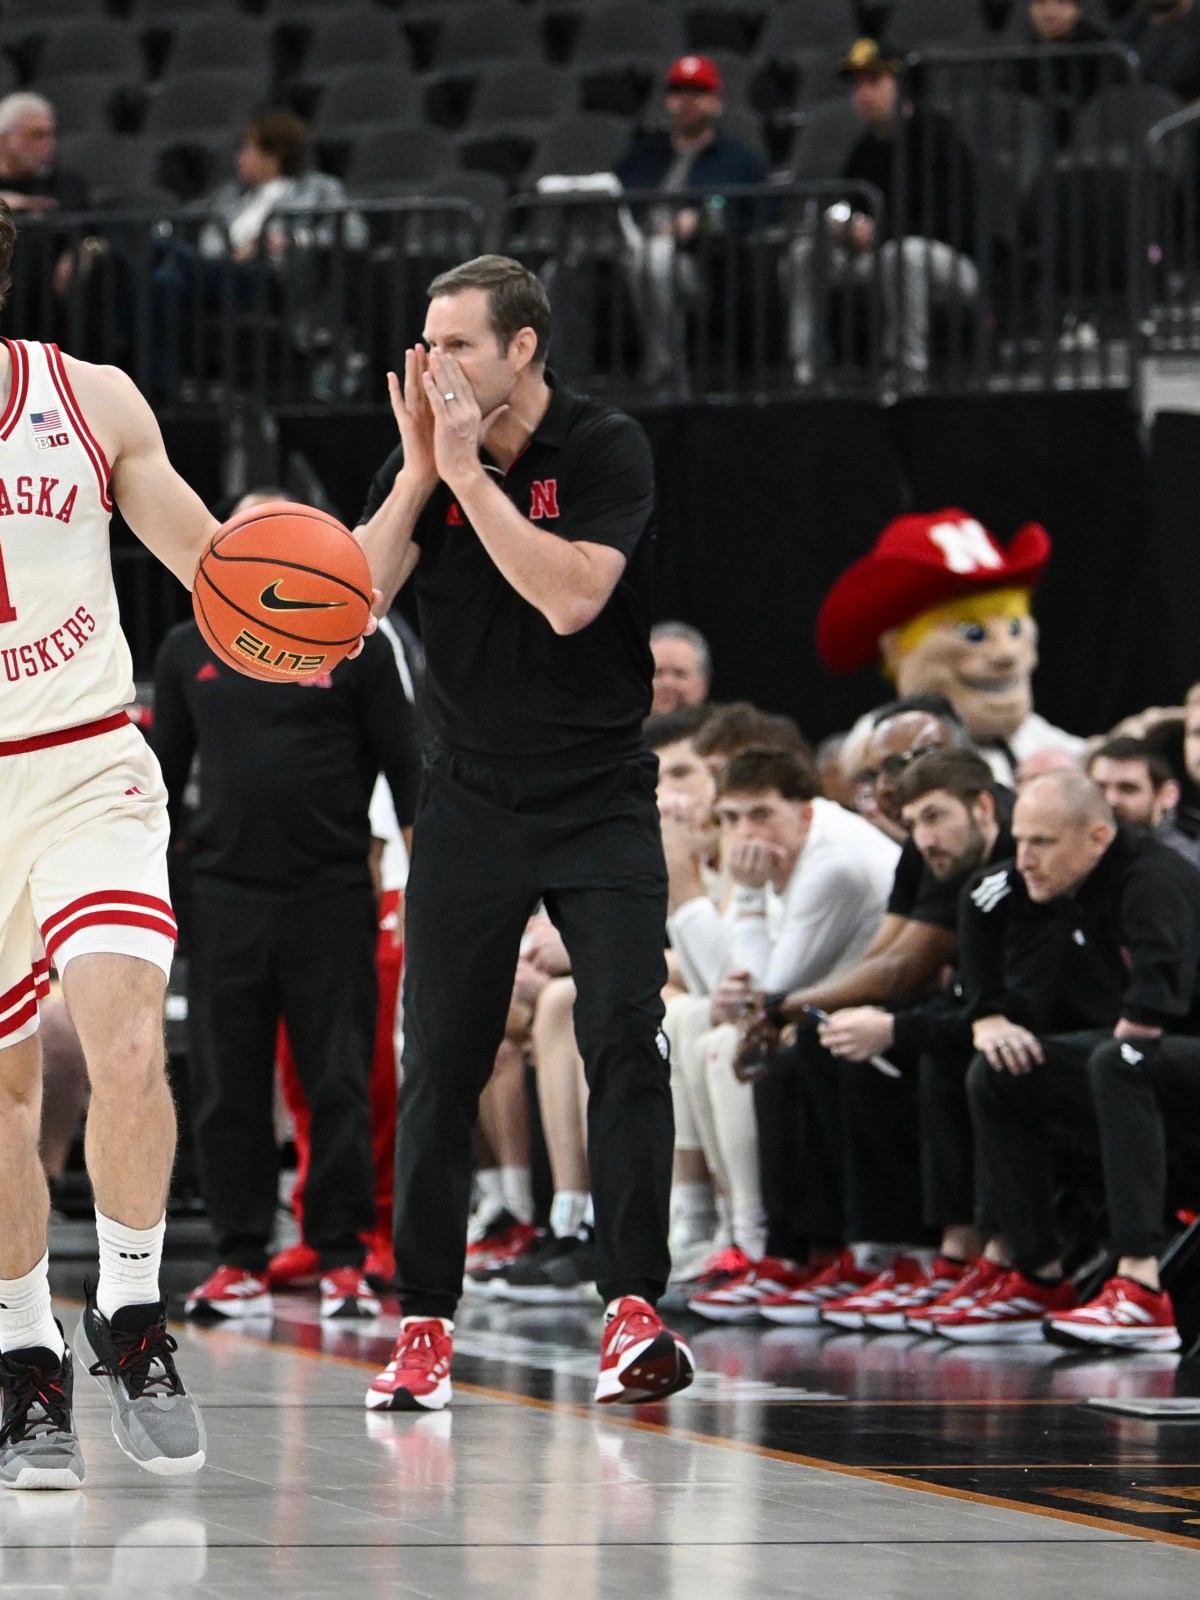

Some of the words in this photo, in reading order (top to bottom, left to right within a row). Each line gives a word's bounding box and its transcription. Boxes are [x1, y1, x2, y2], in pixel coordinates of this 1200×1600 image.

[529, 478, 560, 519] N
[928, 518, 1002, 574] N
[233, 627, 328, 672] ELITE
